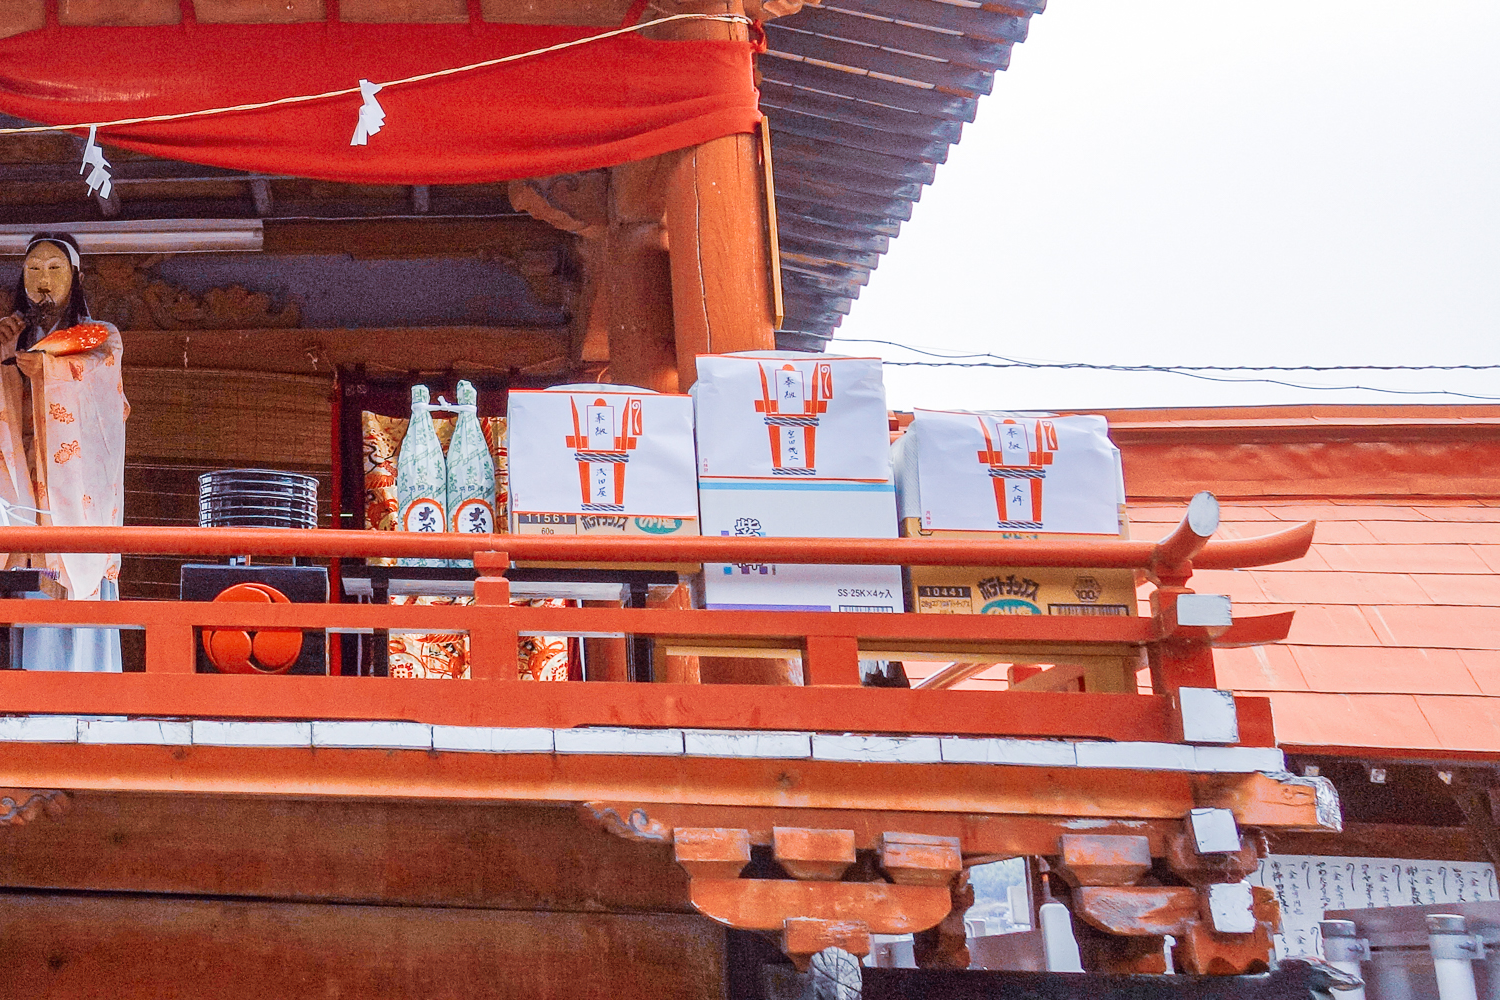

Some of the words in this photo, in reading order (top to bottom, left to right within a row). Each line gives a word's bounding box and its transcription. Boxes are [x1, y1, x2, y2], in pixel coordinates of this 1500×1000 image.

[526, 513, 569, 524] 11561
[925, 587, 964, 597] 10441
[977, 573, 1040, 602] ポテトチップス
